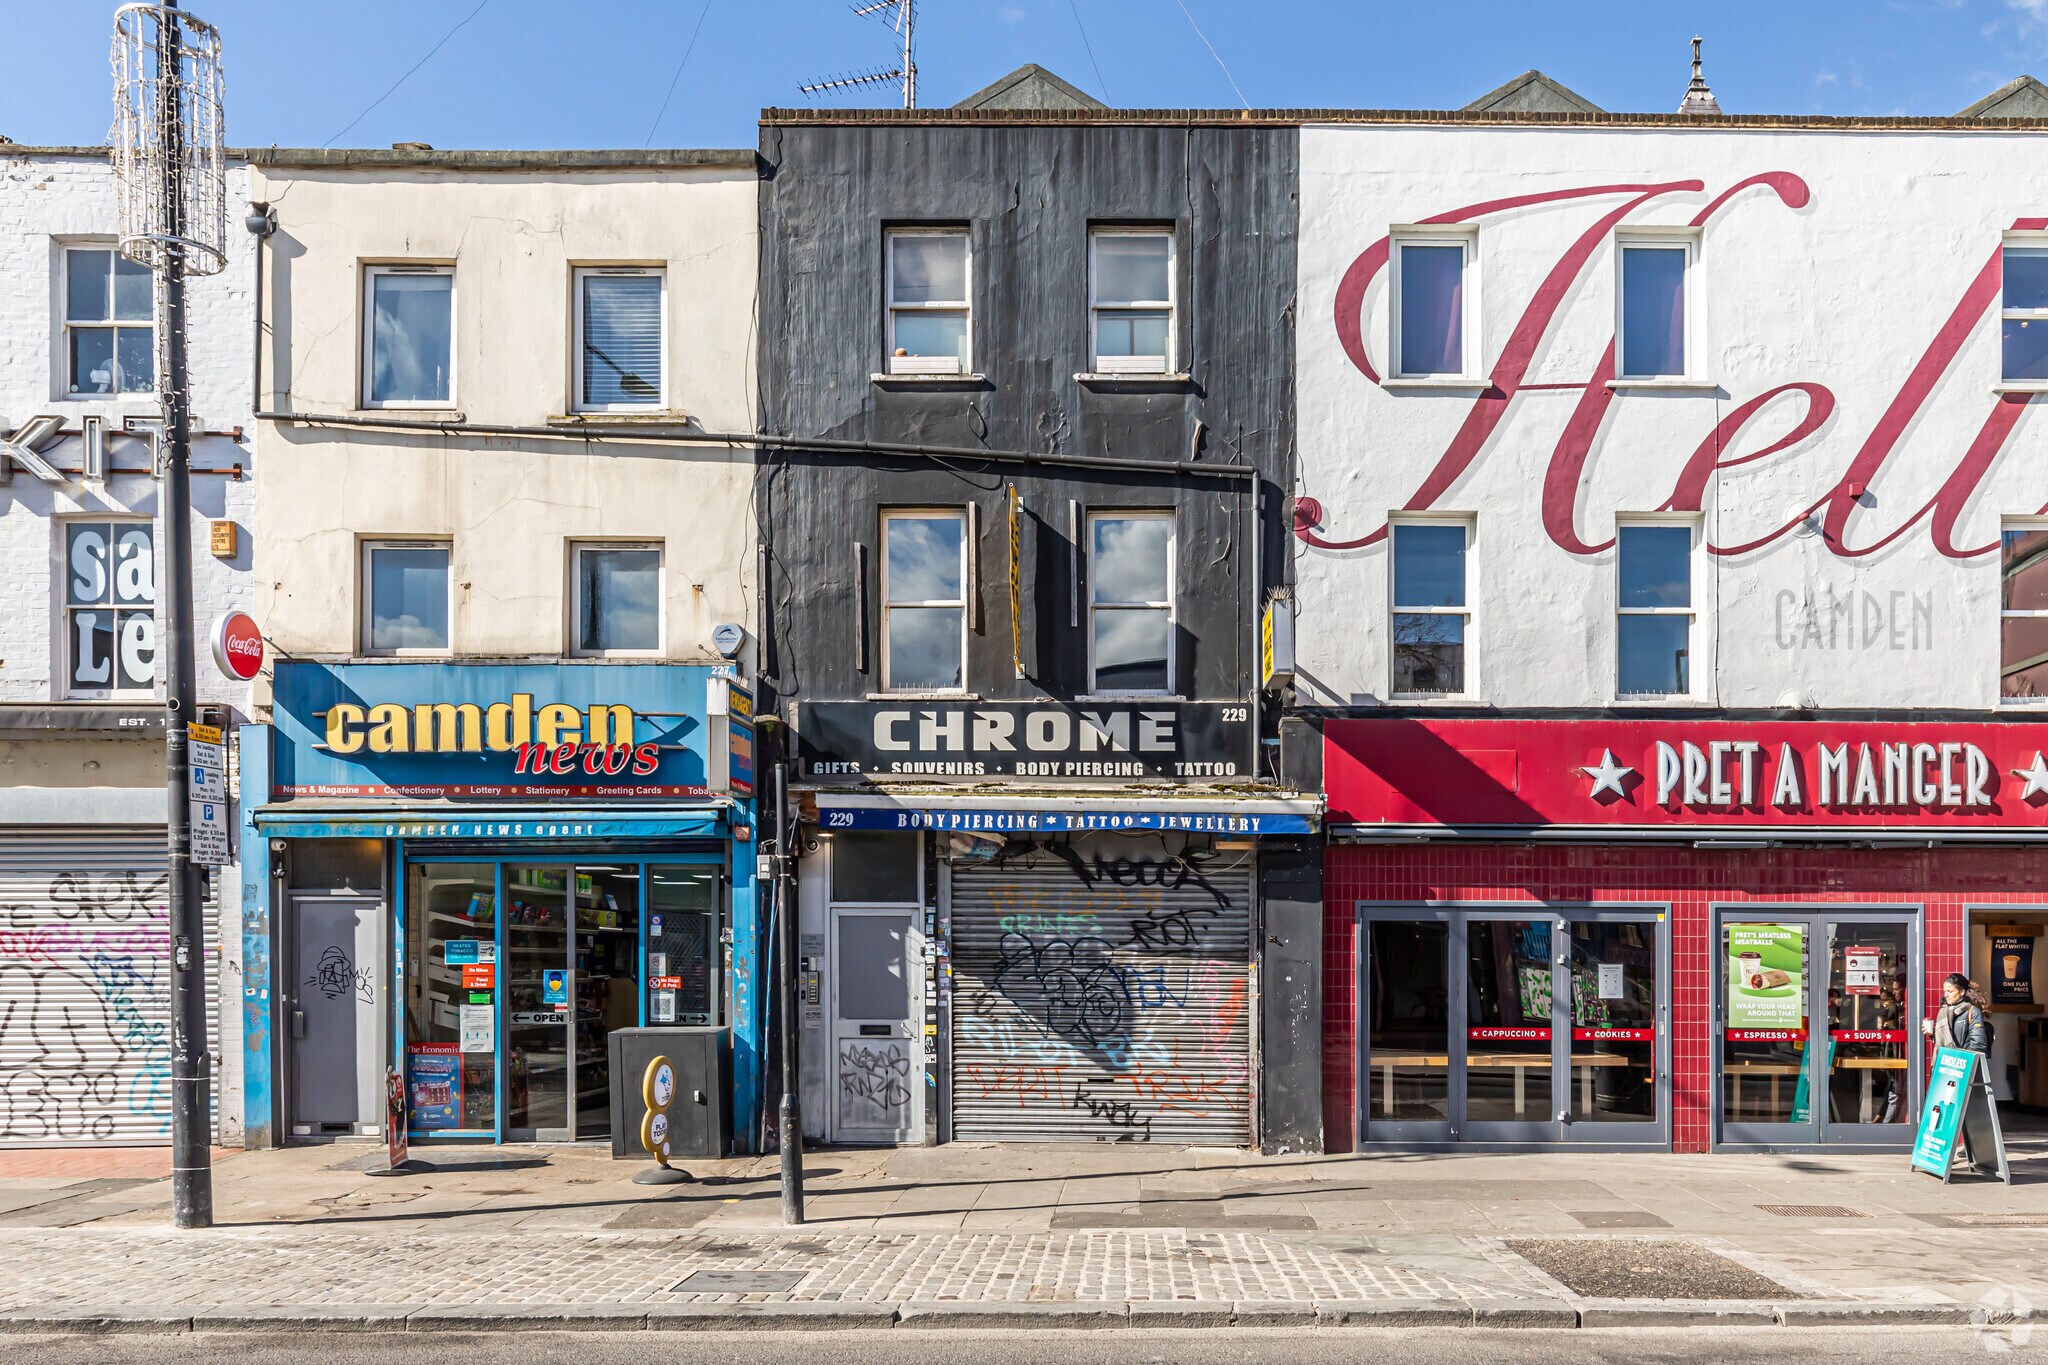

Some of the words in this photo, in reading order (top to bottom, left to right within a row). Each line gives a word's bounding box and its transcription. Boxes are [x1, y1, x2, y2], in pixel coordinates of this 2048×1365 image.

[1776, 590, 1932, 651] CAMDEN
[1222, 709, 1247, 722] 229
[119, 718, 150, 726] EST.
[325, 692, 635, 753] camden
[873, 711, 1176, 751] CHROME
[514, 740, 659, 775] news
[814, 762, 861, 774] GIFTS
[1016, 762, 1060, 776] BODY
[1066, 762, 1144, 776] PIERCING
[1175, 762, 1236, 776] TATTOO
[1656, 740, 1760, 805] PRET
[1773, 741, 1801, 806] A
[1819, 741, 1991, 807] MANGER
[283, 785, 307, 793] News
[309, 785, 316, 793] &
[318, 785, 360, 795] Magazine
[384, 785, 445, 796] Confectionery
[470, 785, 501, 796] Lottery
[525, 786, 570, 796] Stationery
[597, 786, 634, 796] Greeting
[636, 786, 662, 795] Cards
[829, 812, 854, 827] 229
[897, 813, 945, 828] BODY
[951, 814, 1038, 828] PIERCING
[1065, 815, 1134, 828] TATTOO
[1158, 816, 1261, 831] JEWELLERY
[474, 824, 523, 836] NEWS
[536, 824, 593, 837] agent
[533, 1014, 564, 1022] OPEN
[1594, 1030, 1631, 1038] COOKIES
[1744, 1031, 1787, 1039] ESPRESSO
[1854, 1032, 1882, 1040] SOUPS
[1940, 1055, 1967, 1069] ENDLESS
